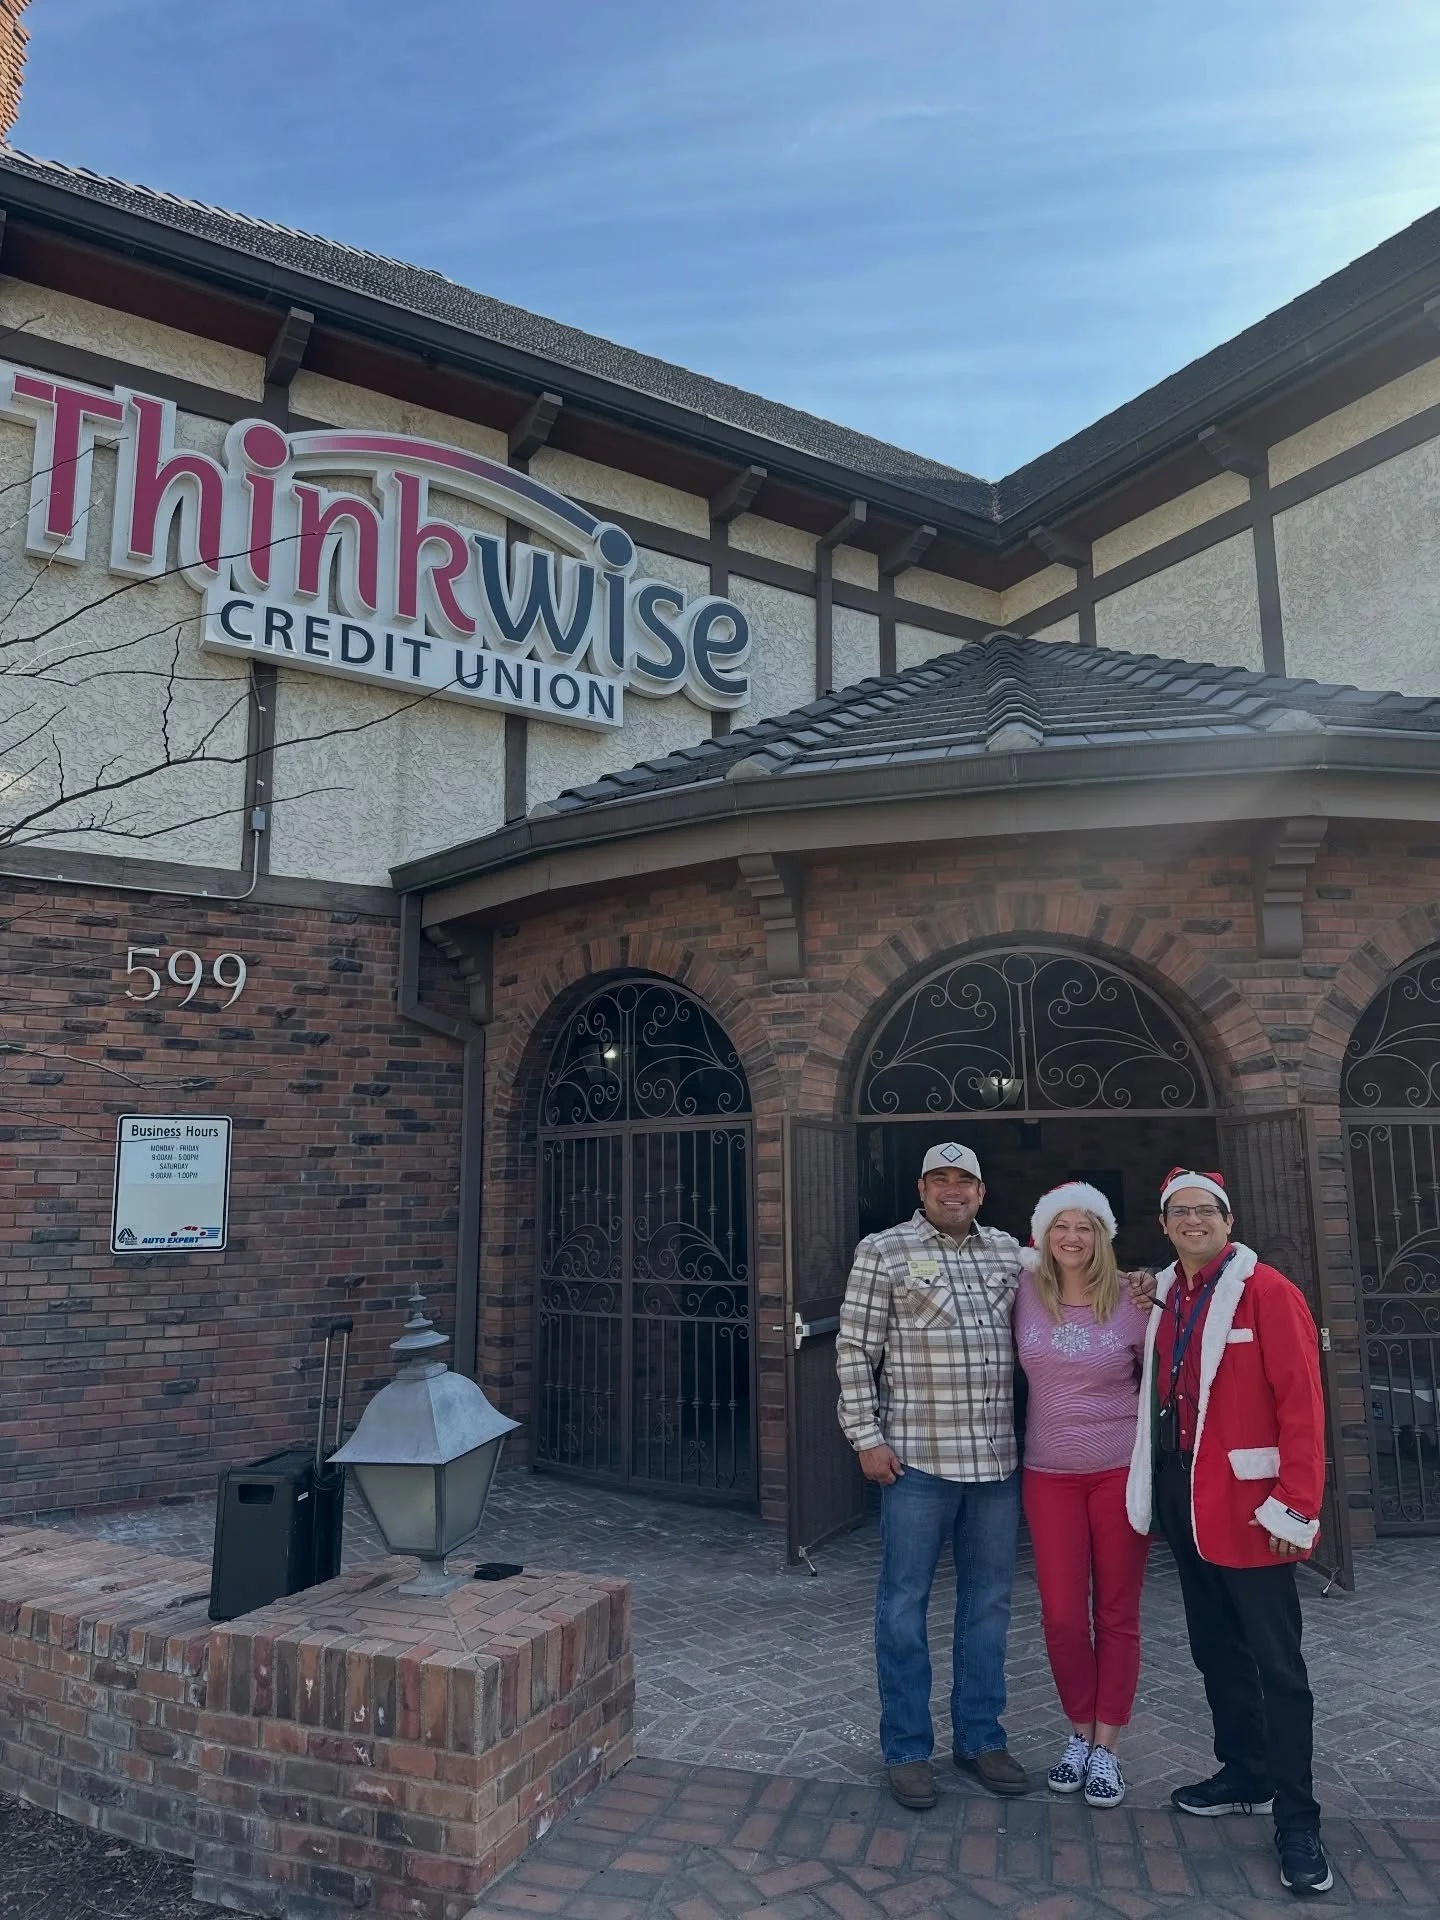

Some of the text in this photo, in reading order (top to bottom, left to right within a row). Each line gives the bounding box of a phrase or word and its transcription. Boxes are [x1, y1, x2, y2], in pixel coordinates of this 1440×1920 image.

[13, 373, 750, 696] Thinkwise
[220, 599, 615, 720] CREDIT UNION
[125, 946, 247, 1009] 599
[131, 1124, 219, 1137] Business Hours
[179, 1144, 199, 1152] FRIDAY
[159, 1162, 189, 1170] SATURDAY
[167, 1236, 199, 1244] EXPERT
